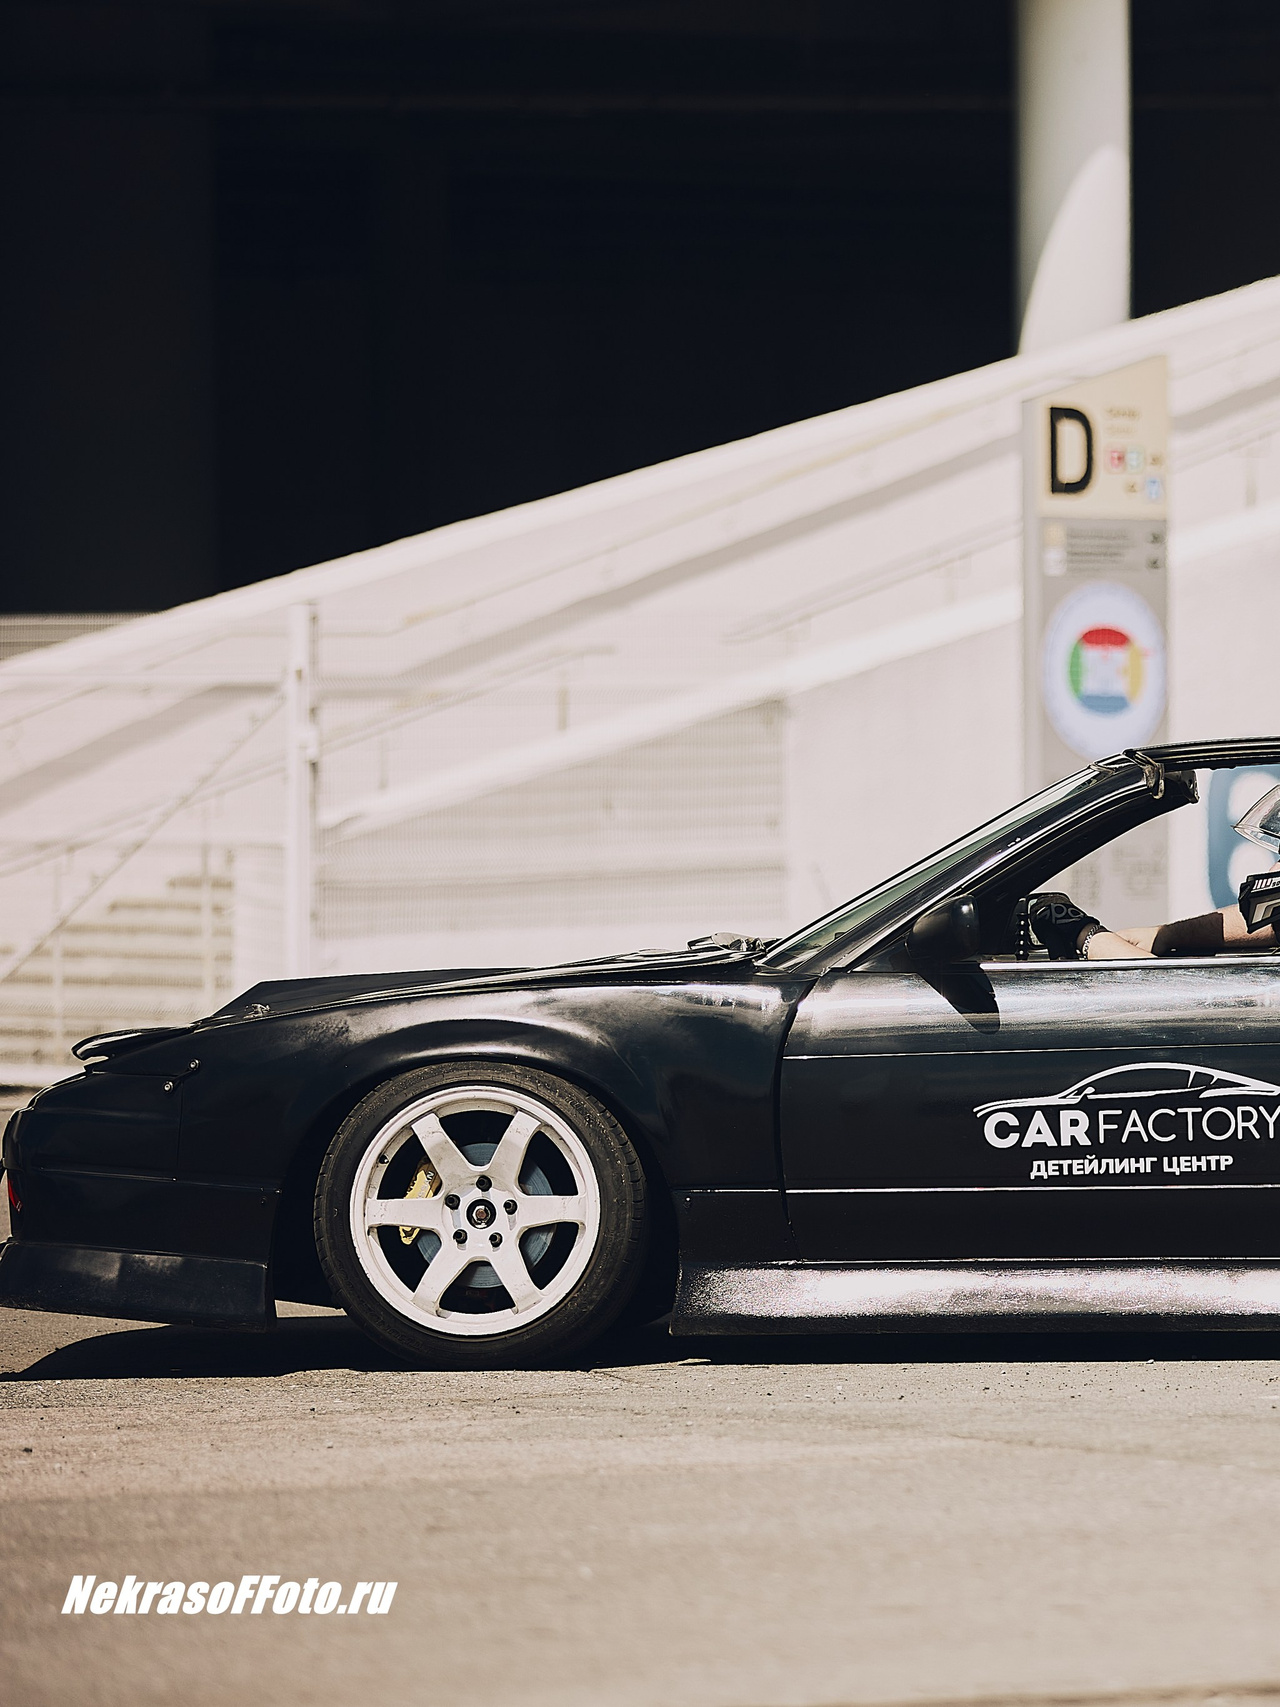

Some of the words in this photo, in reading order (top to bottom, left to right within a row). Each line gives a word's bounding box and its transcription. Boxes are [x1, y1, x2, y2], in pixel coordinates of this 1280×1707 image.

[1050, 407, 1093, 493] D
[983, 1110, 1092, 1149] CAR
[1030, 1154, 1158, 1180] ДЕТЕЙЛИНГ
[1163, 1155, 1234, 1175] ЦЕНТР
